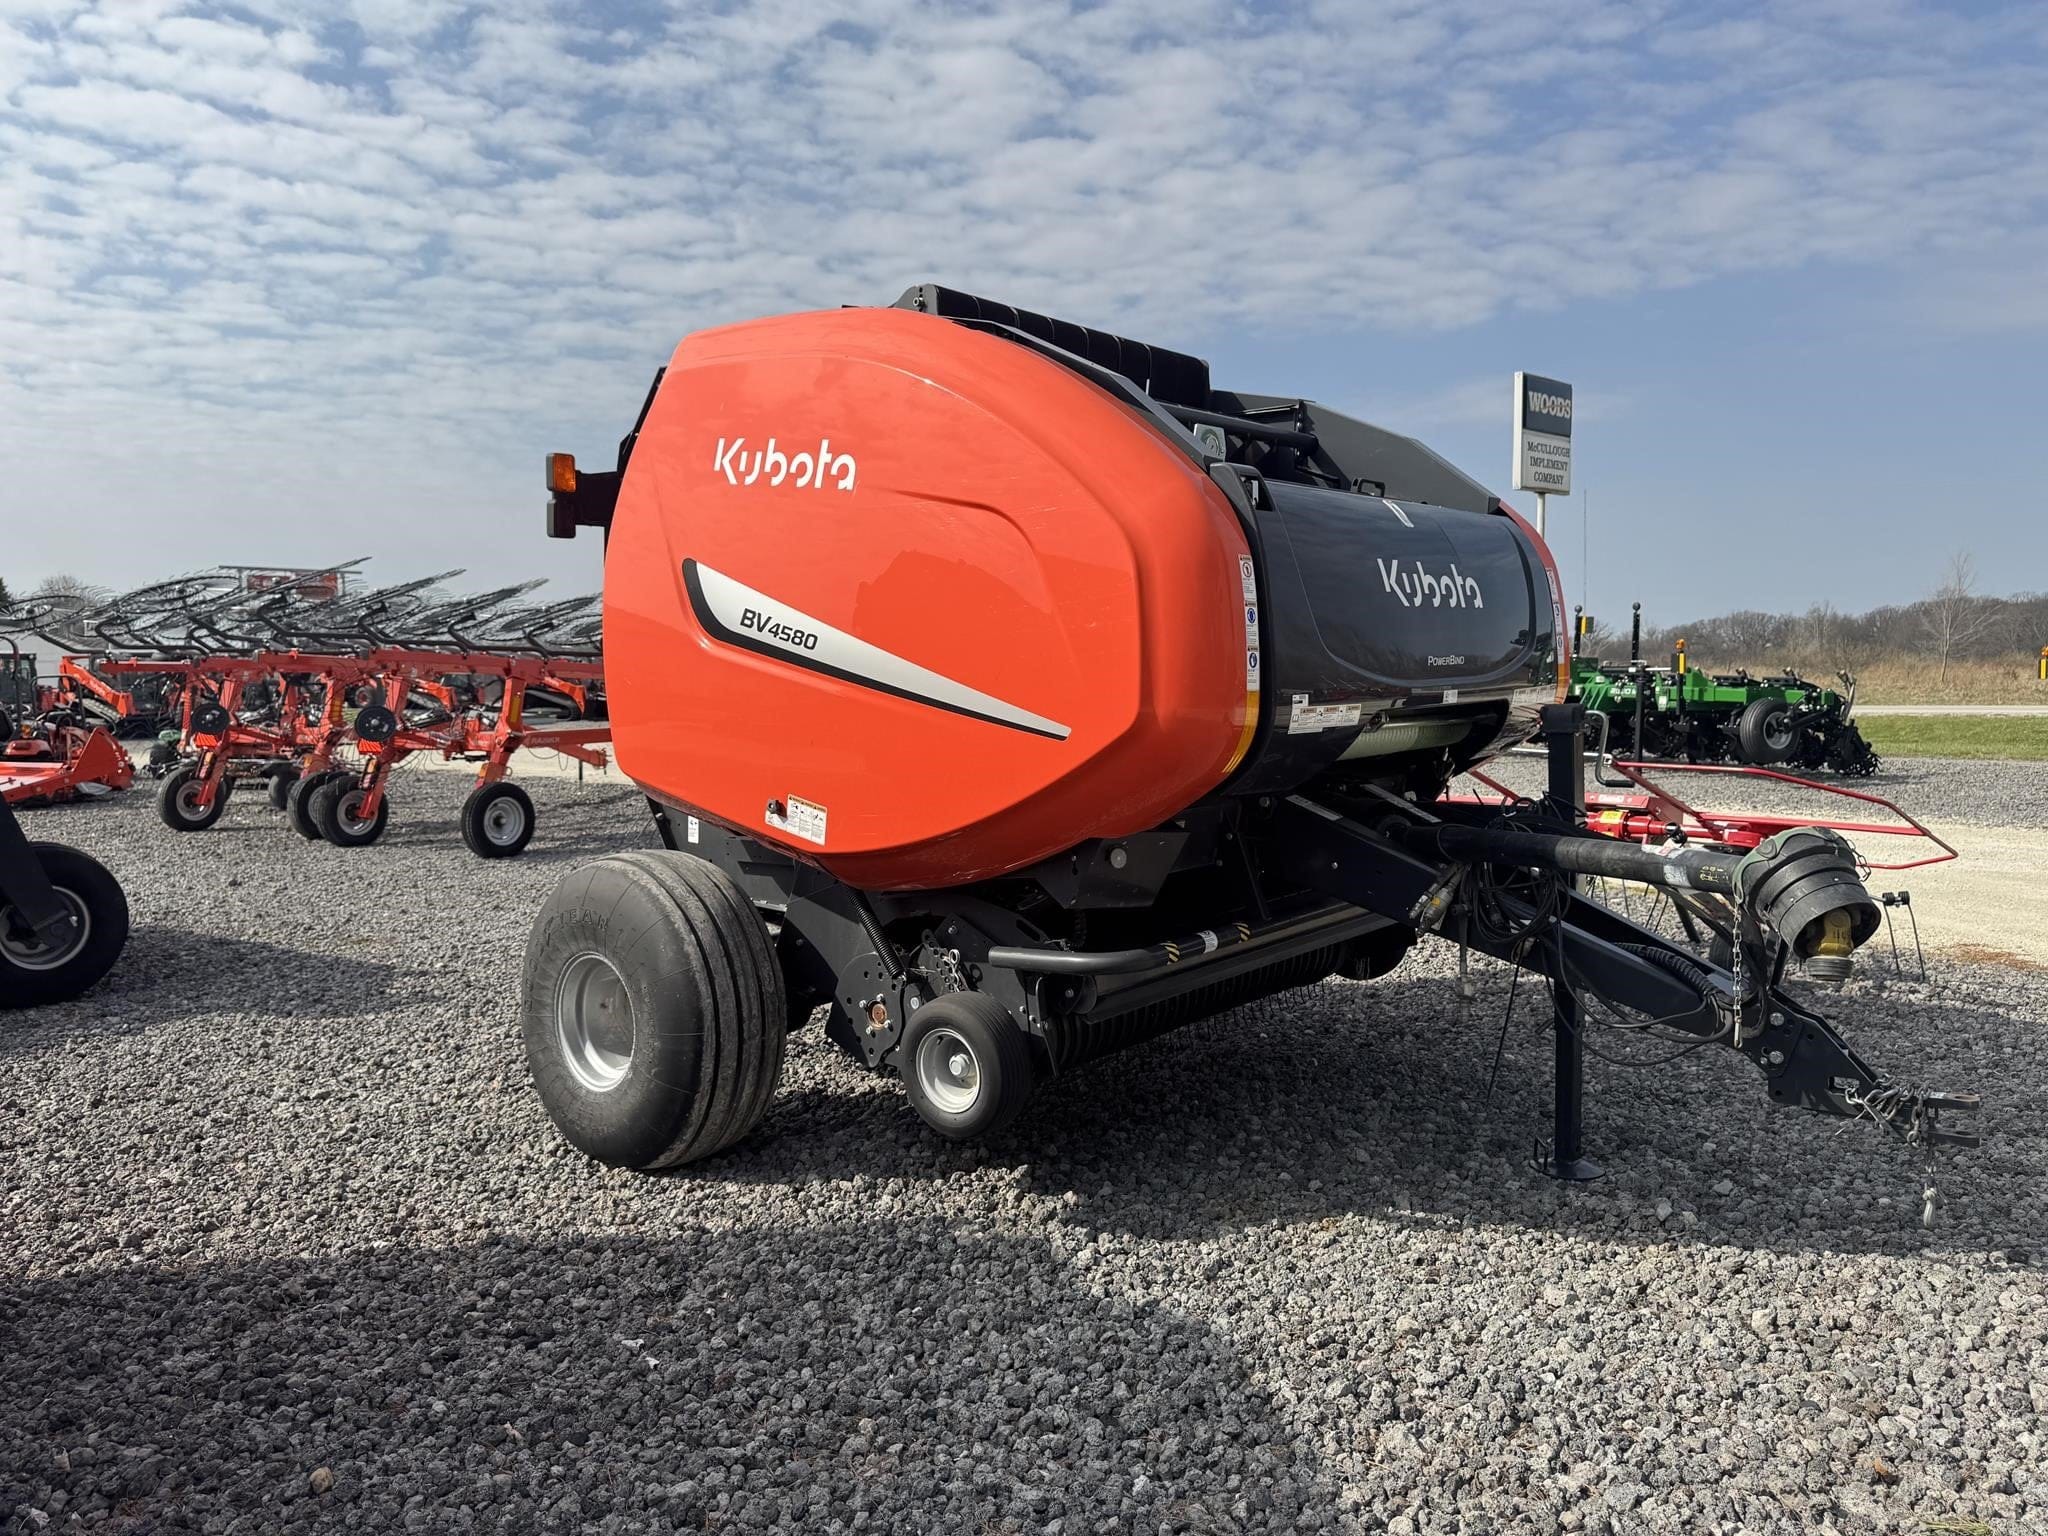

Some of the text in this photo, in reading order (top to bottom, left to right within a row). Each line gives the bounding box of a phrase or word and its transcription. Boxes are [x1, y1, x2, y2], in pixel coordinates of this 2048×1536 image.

[1529, 391, 1571, 418] WOODS
[1527, 441, 1570, 458] McCULLOUGH
[714, 437, 856, 490] Kubota
[1530, 456, 1568, 472] IMPLEMENT
[1533, 471, 1564, 486] COMPANY
[1377, 558, 1483, 608] Kubota
[740, 608, 818, 650] BV4580
